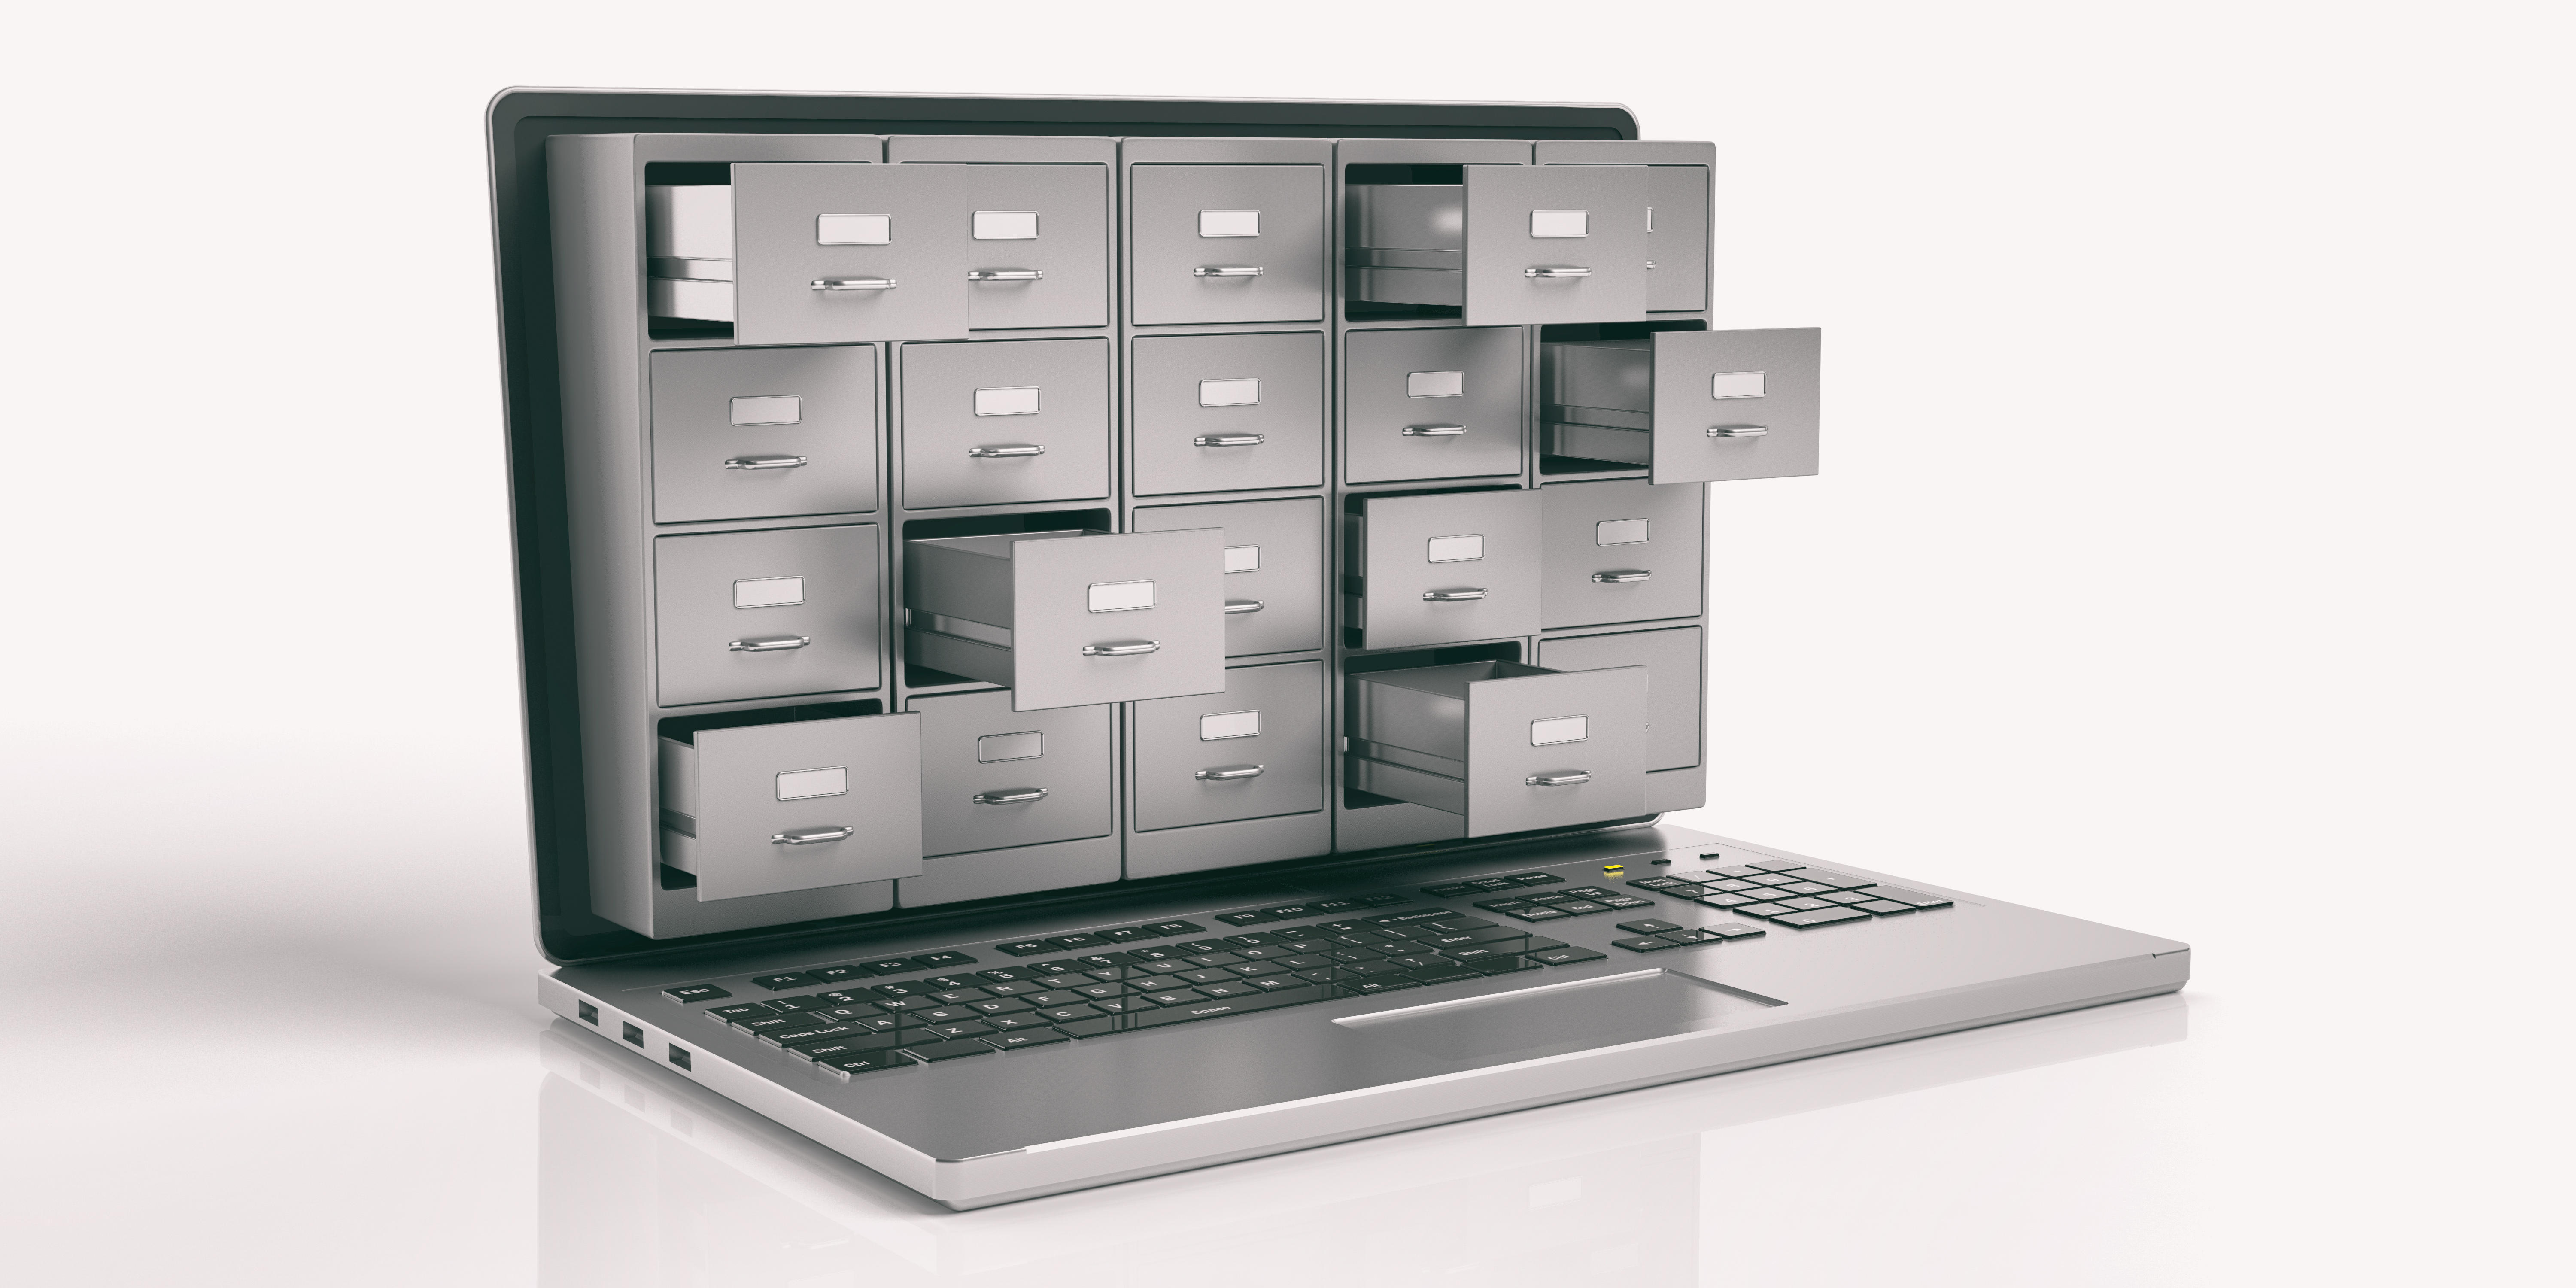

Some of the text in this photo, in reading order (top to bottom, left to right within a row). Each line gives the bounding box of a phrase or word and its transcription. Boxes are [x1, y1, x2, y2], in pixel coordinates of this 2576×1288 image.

[1397, 911, 1452, 920] Backspace
[680, 987, 709, 995] Esc
[1191, 1006, 1231, 1015] Space
[780, 1026, 850, 1039] Caps Lock
[812, 1045, 848, 1054] Shift
